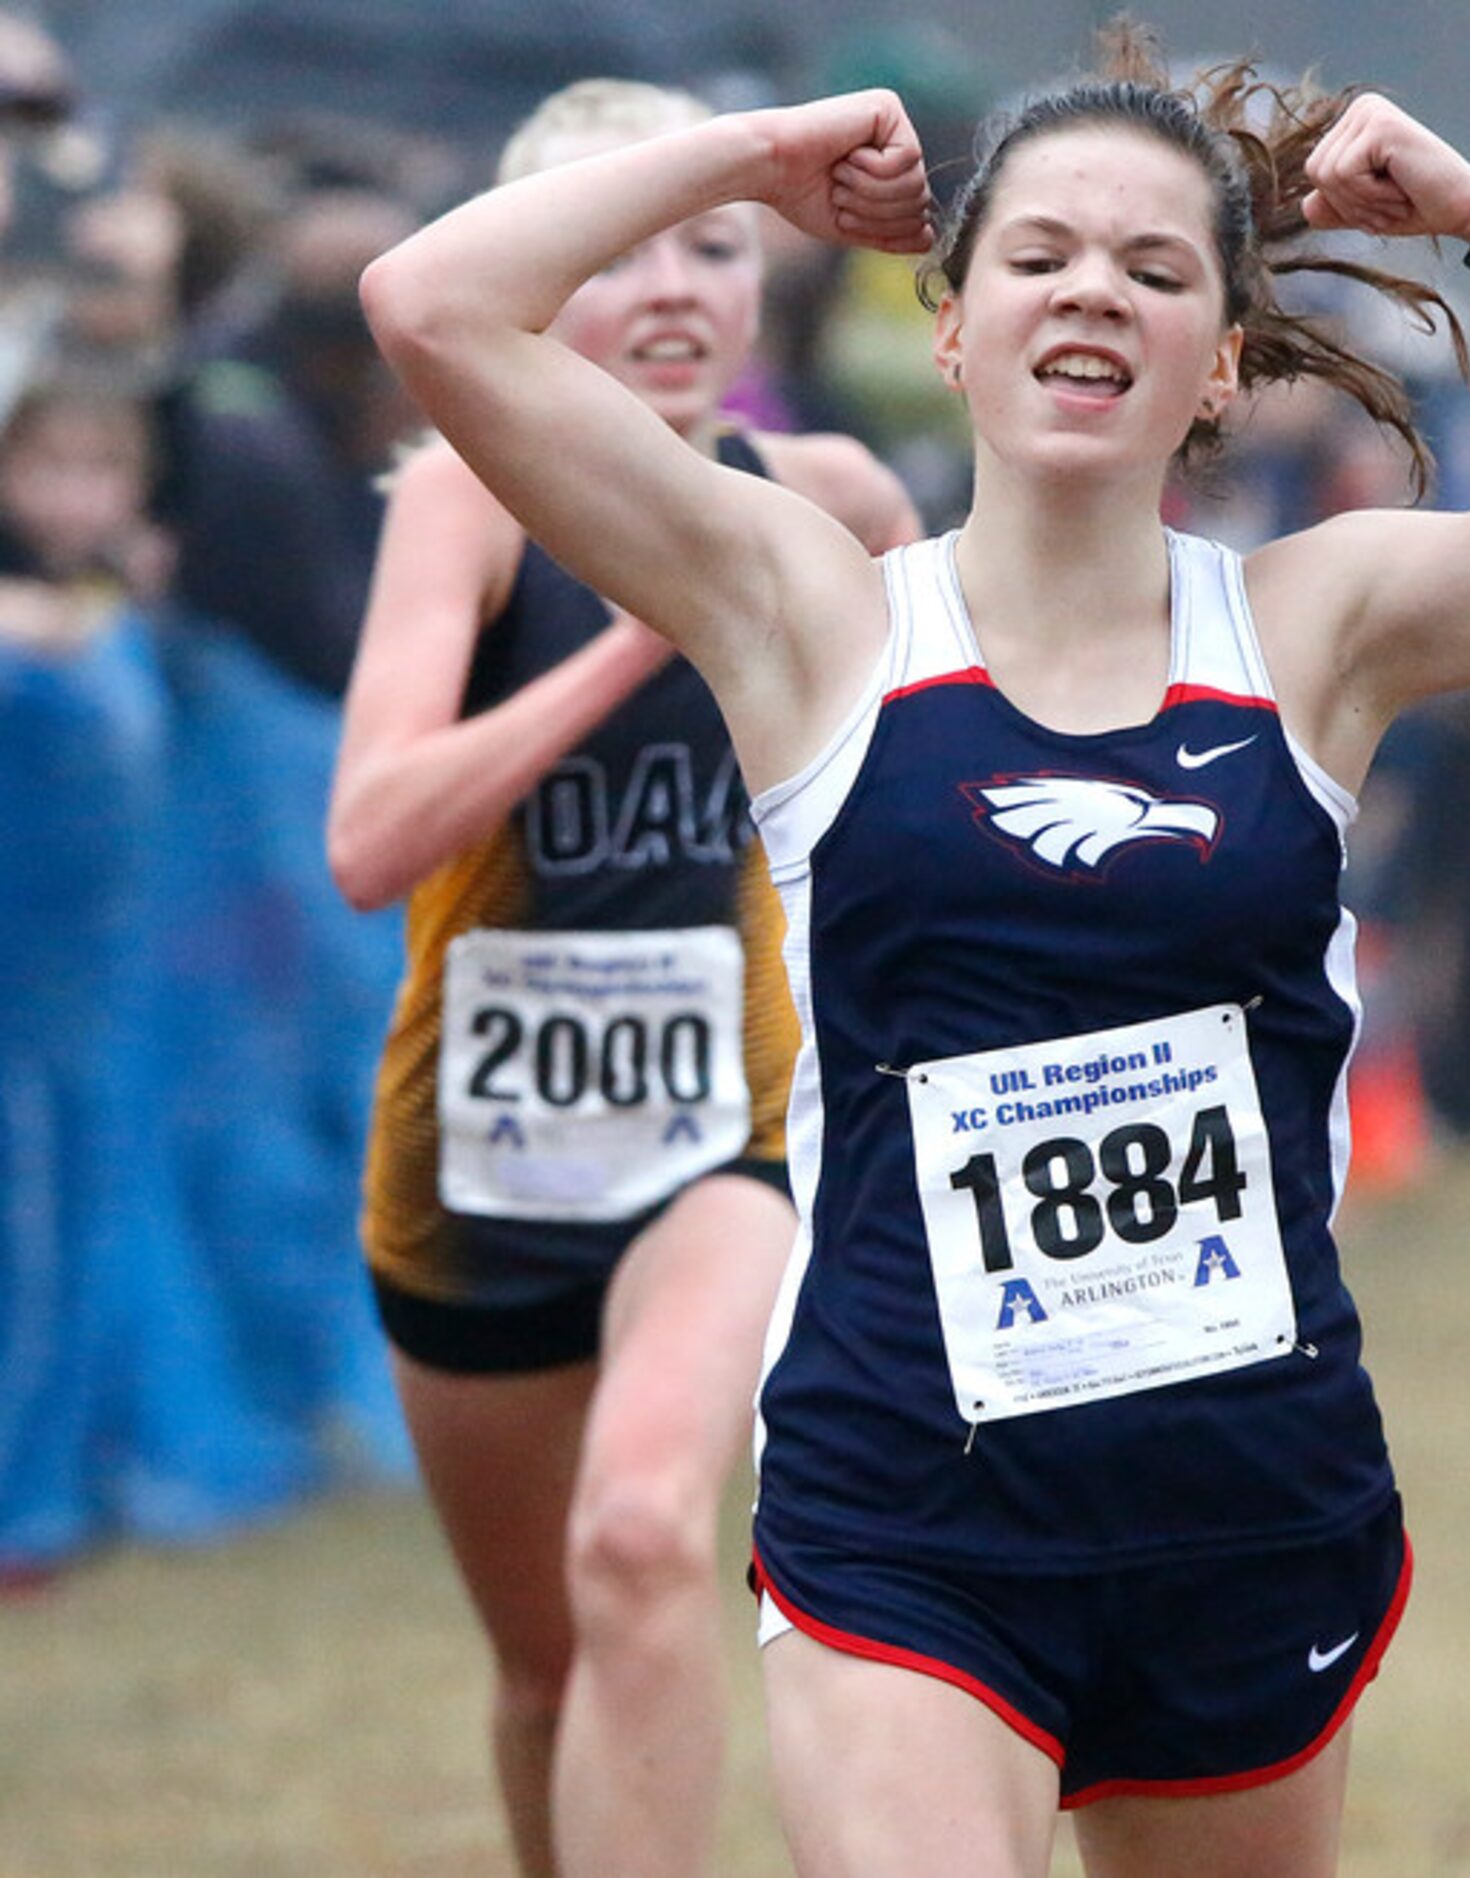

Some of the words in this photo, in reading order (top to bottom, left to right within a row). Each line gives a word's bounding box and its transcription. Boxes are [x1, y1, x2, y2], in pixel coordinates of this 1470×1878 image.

[468, 1006, 712, 1108] 2000
[989, 1069, 1037, 1095] UIL
[1043, 1051, 1148, 1087] Region
[1152, 1041, 1173, 1065] II
[951, 1107, 989, 1133] XC
[996, 1065, 1219, 1127] Championships
[949, 1104, 1248, 1275] 1884
[1061, 1267, 1177, 1308] ARLINGTON
[1193, 1233, 1242, 1288] A
[994, 1277, 1049, 1331] A
